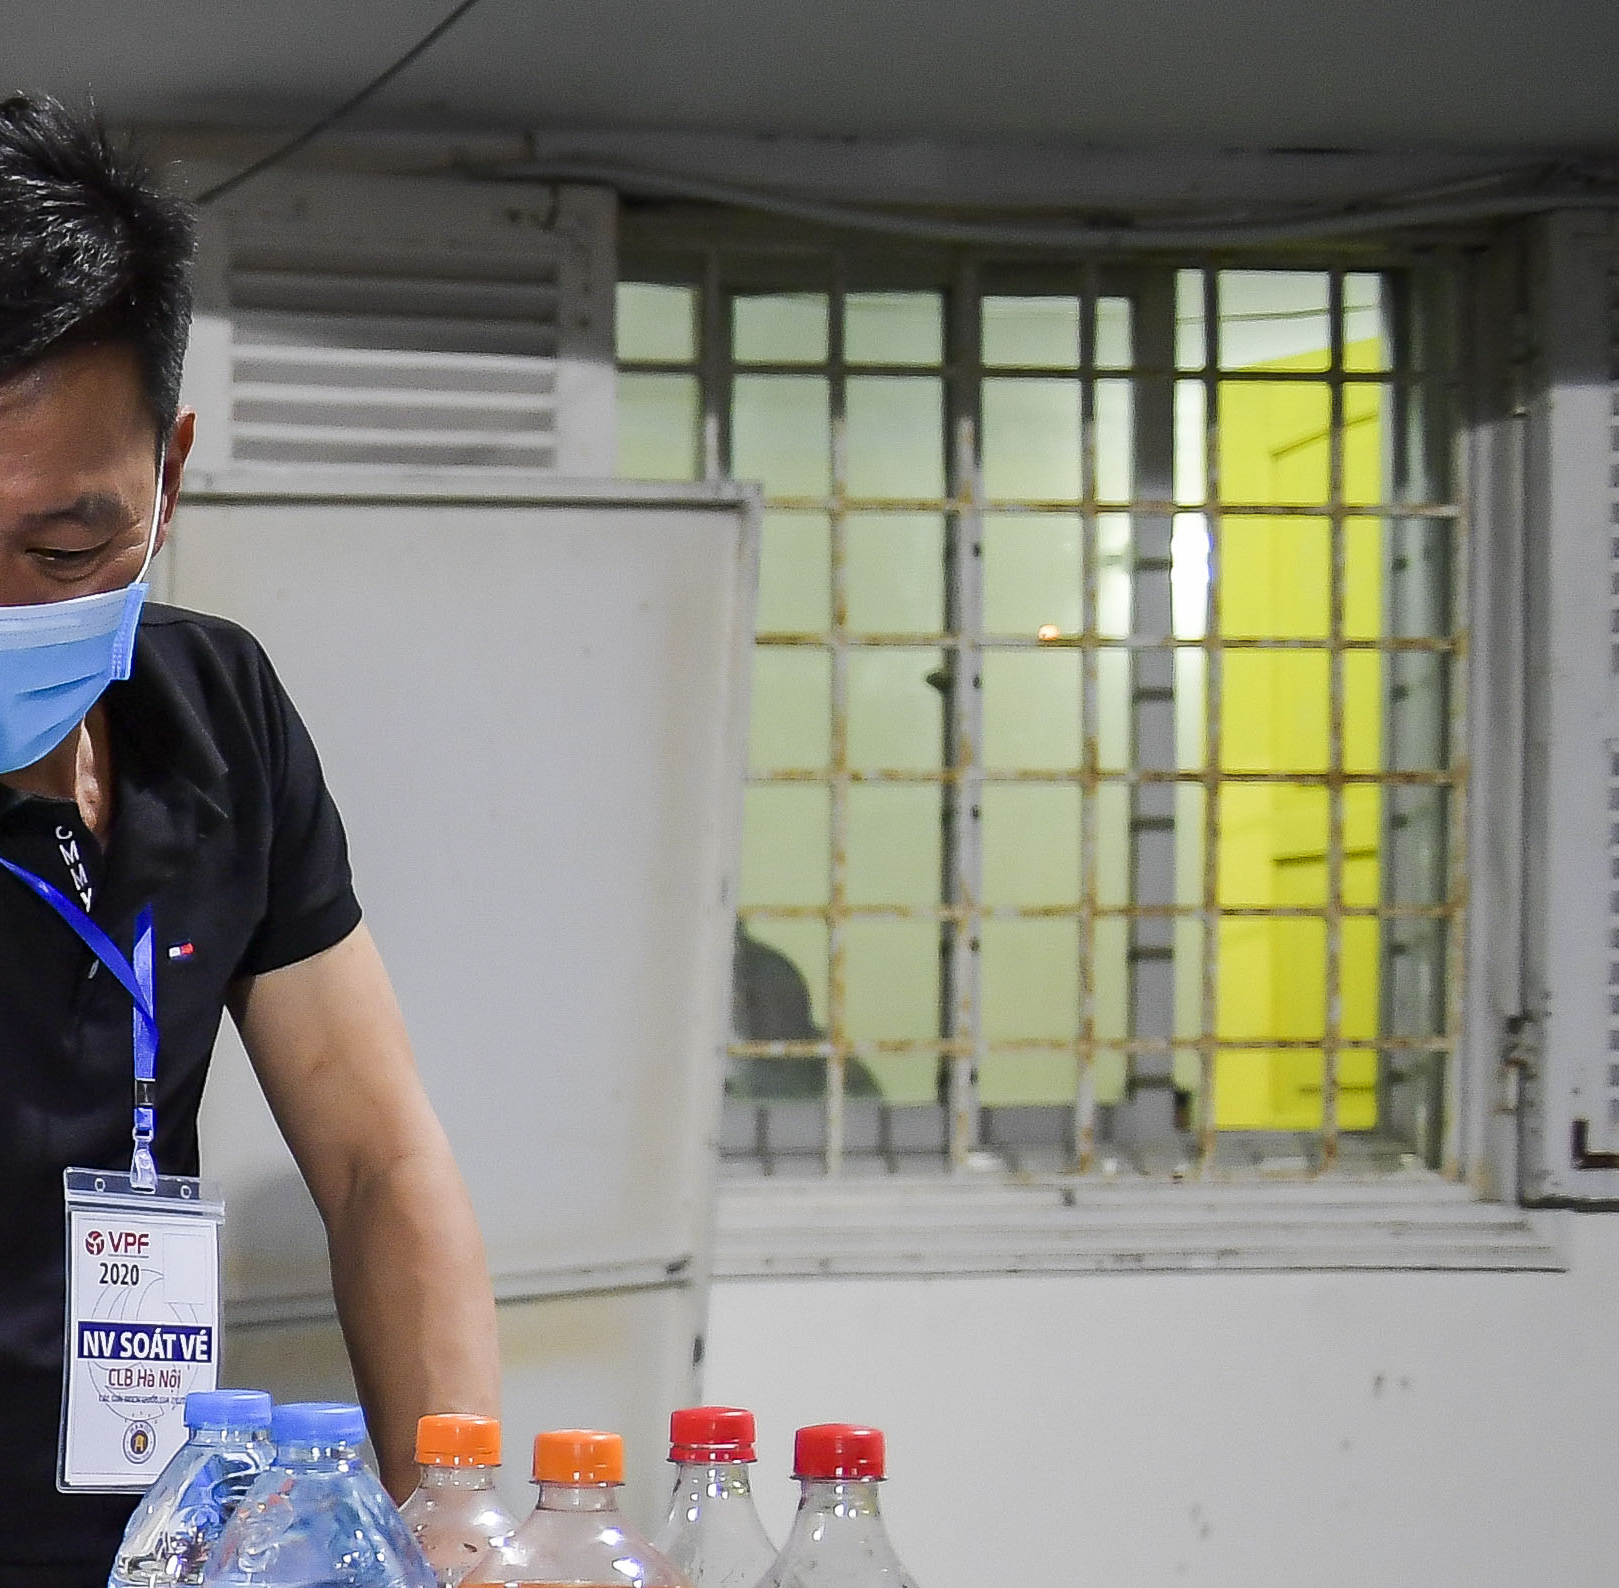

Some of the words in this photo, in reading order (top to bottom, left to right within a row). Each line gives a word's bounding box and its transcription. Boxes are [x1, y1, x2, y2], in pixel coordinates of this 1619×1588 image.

[108, 1231, 150, 1254] VPF
[99, 1263, 140, 1286] 2020
[82, 1331, 116, 1357] NV
[120, 1328, 177, 1359] SOÁT
[180, 1329, 209, 1361] VÉ
[108, 1369, 133, 1387] CLB
[137, 1369, 155, 1388] Hà
